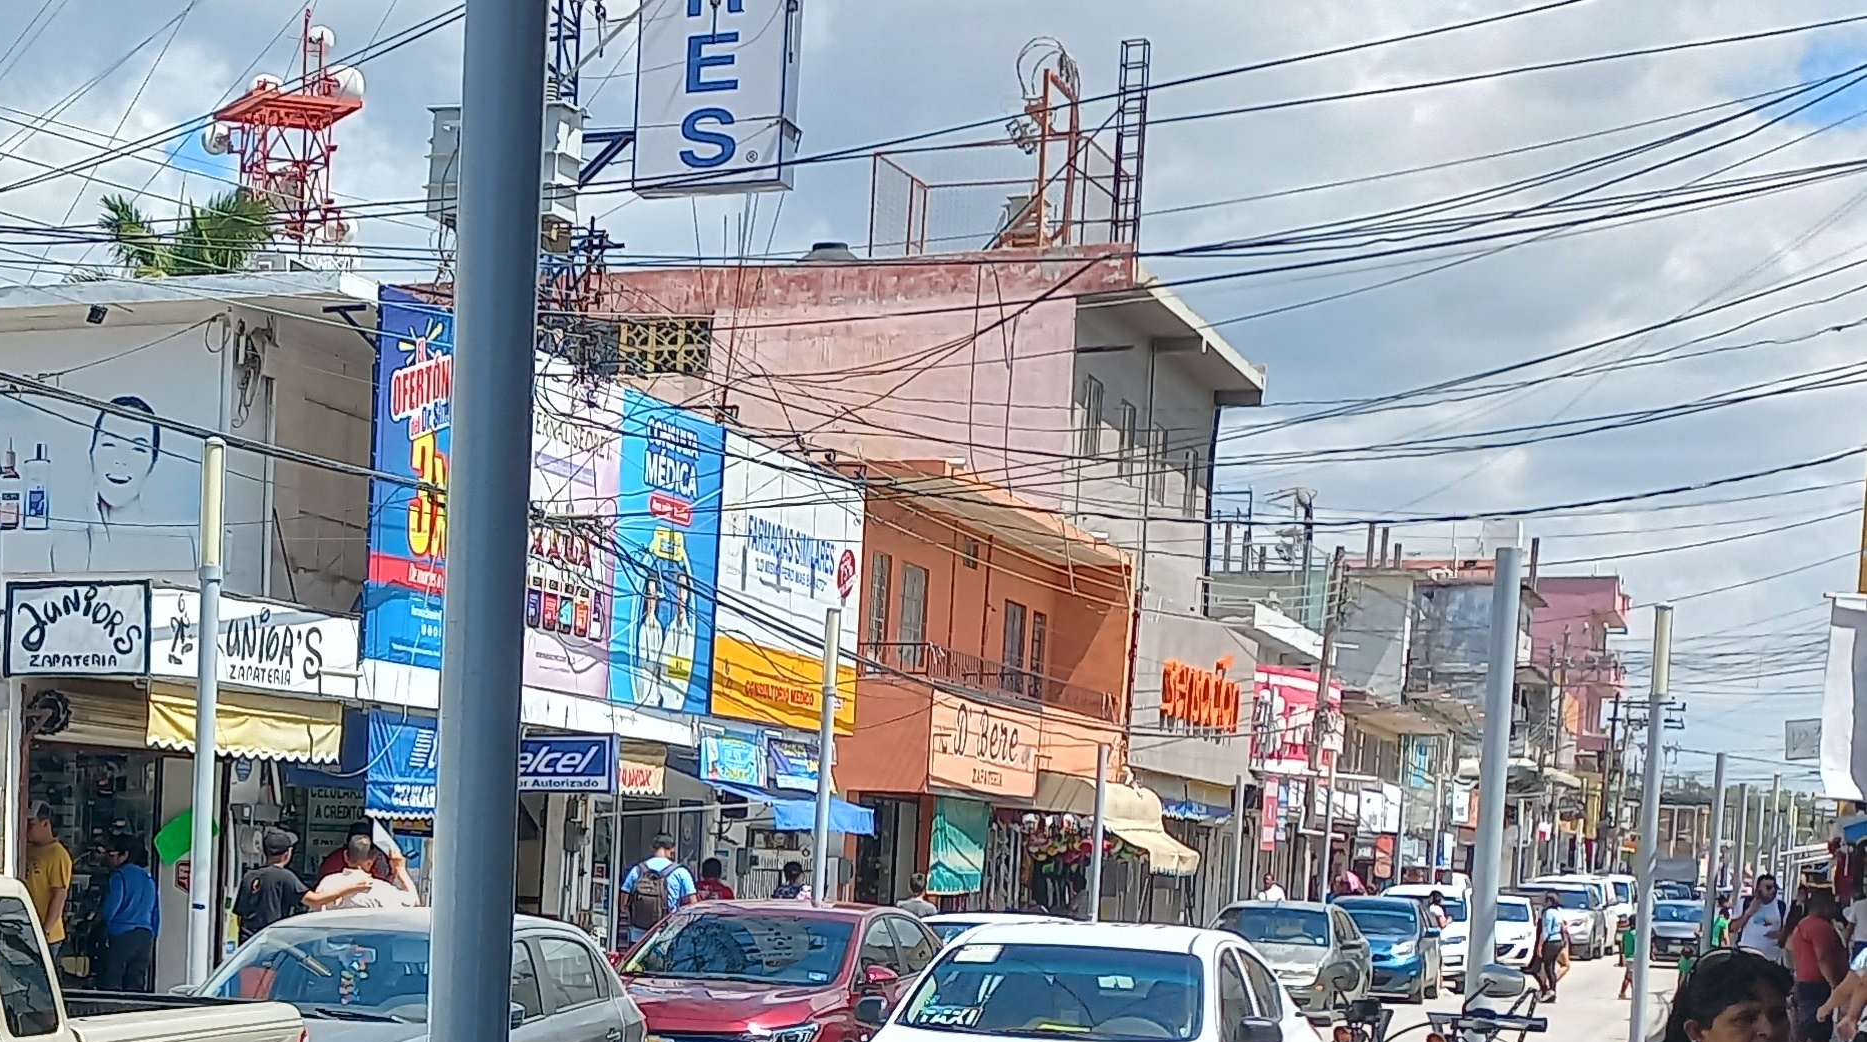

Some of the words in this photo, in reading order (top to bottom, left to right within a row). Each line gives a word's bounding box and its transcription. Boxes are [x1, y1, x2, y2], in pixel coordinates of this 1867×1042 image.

[680, 0, 745, 168] ES
[392, 355, 450, 416] OFERTÓN
[645, 449, 698, 498] MÉDICA
[29, 653, 118, 668] ZAPATERIA
[228, 664, 291, 687] ZAPATERIA
[519, 745, 600, 774] elcel
[531, 778, 599, 788] Autorizado
[315, 804, 322, 818] A
[919, 1008, 978, 1025] TAXI
